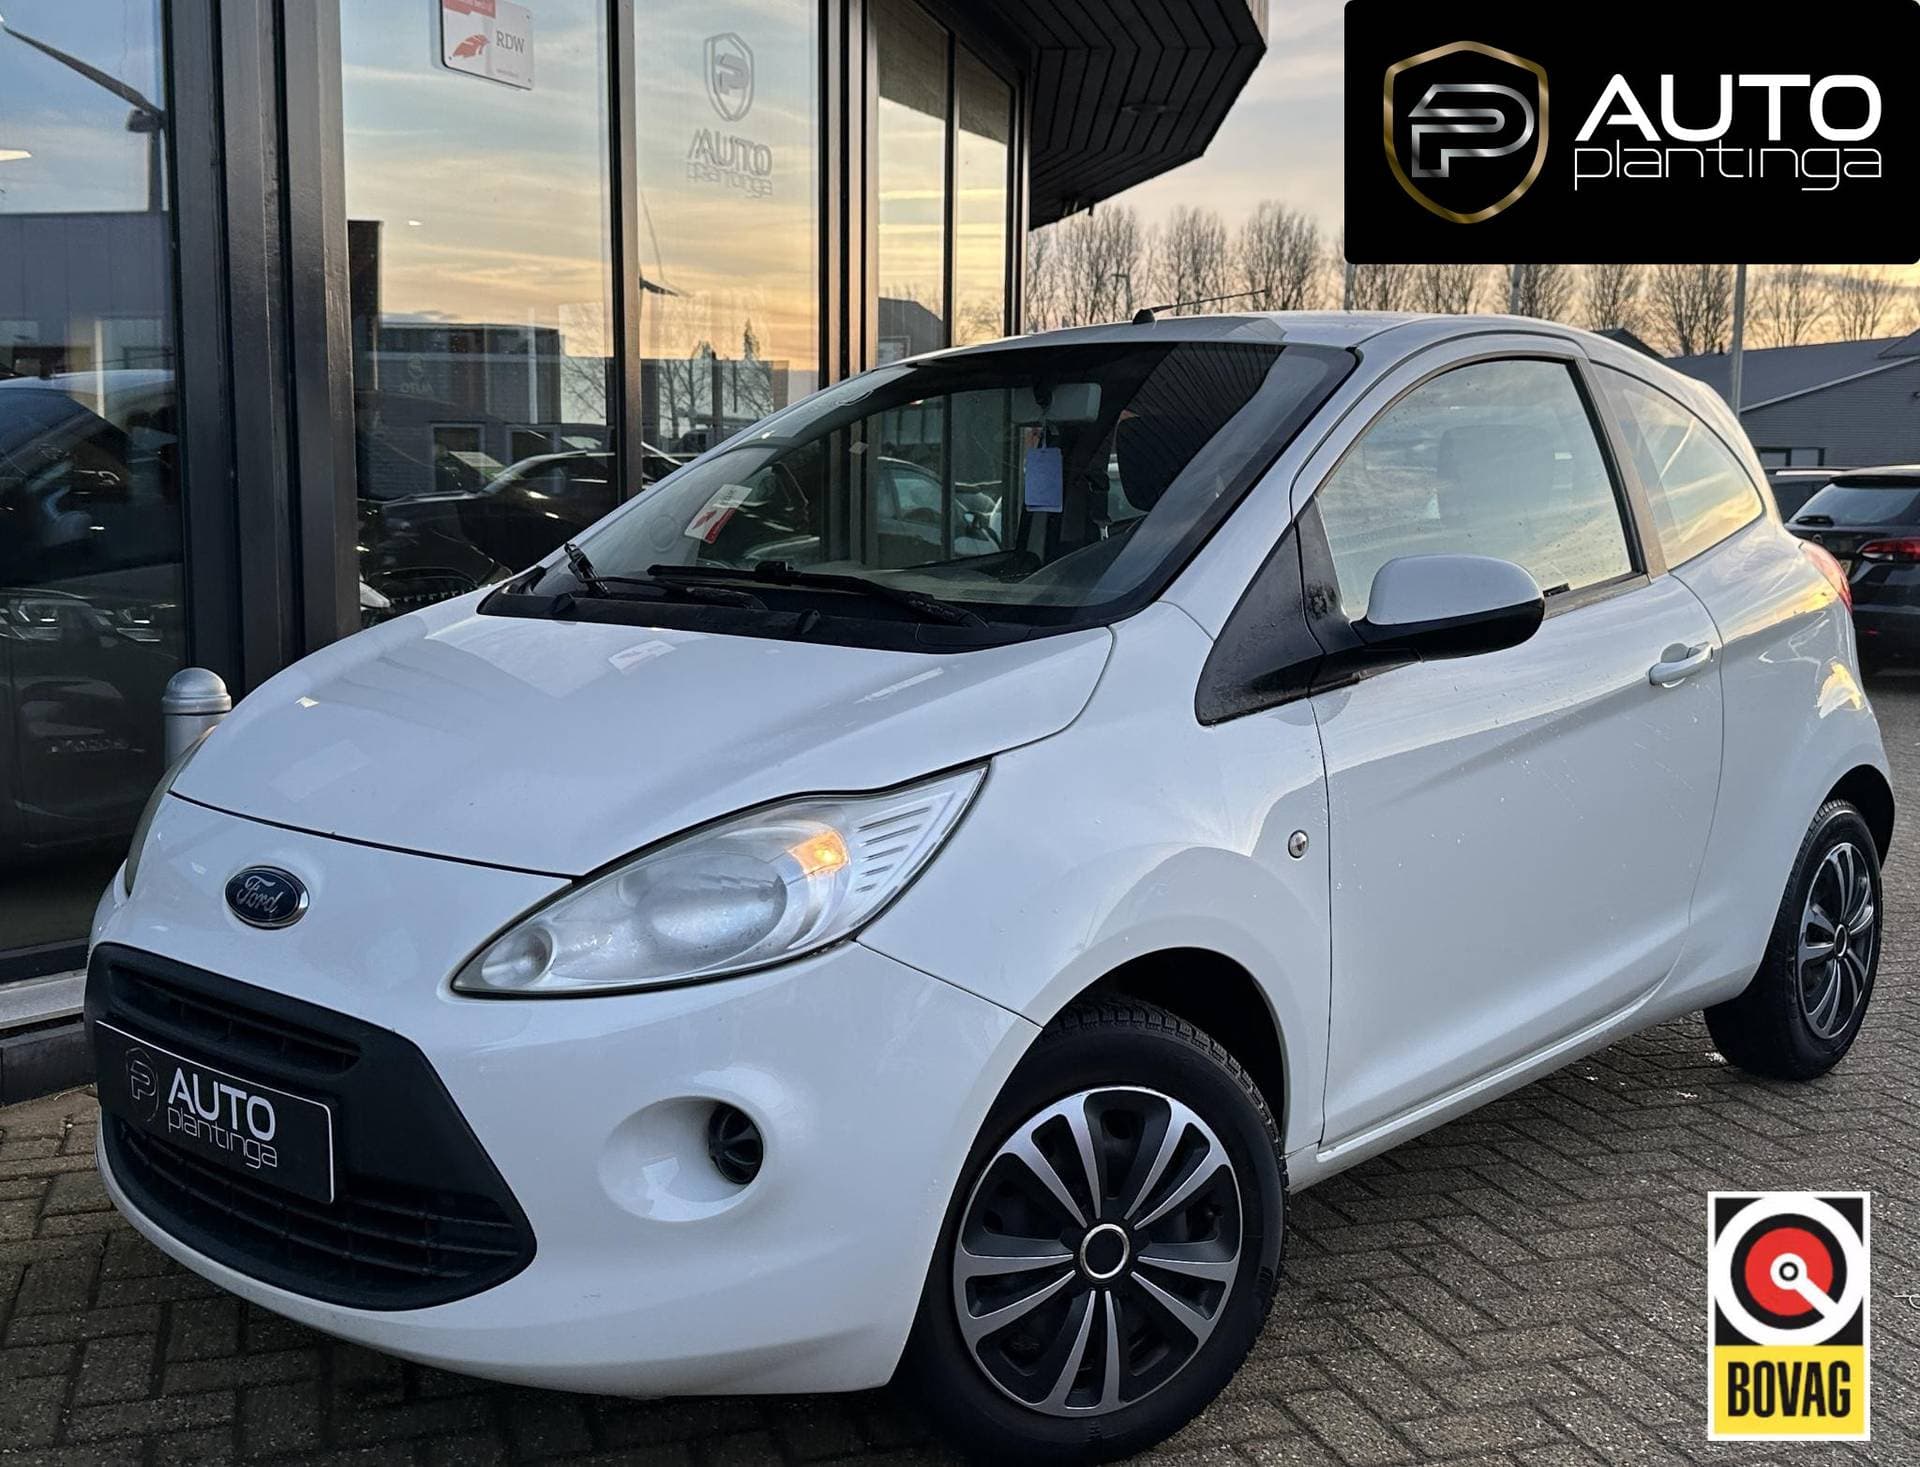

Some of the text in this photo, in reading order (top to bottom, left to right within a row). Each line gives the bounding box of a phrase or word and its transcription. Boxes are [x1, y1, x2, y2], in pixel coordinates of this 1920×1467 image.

[496, 30, 525, 53] RDW
[687, 128, 773, 177] AUTO
[236, 875, 284, 913] Ford
[168, 1067, 276, 1141] AUTO
[168, 1107, 278, 1169] plantinga
